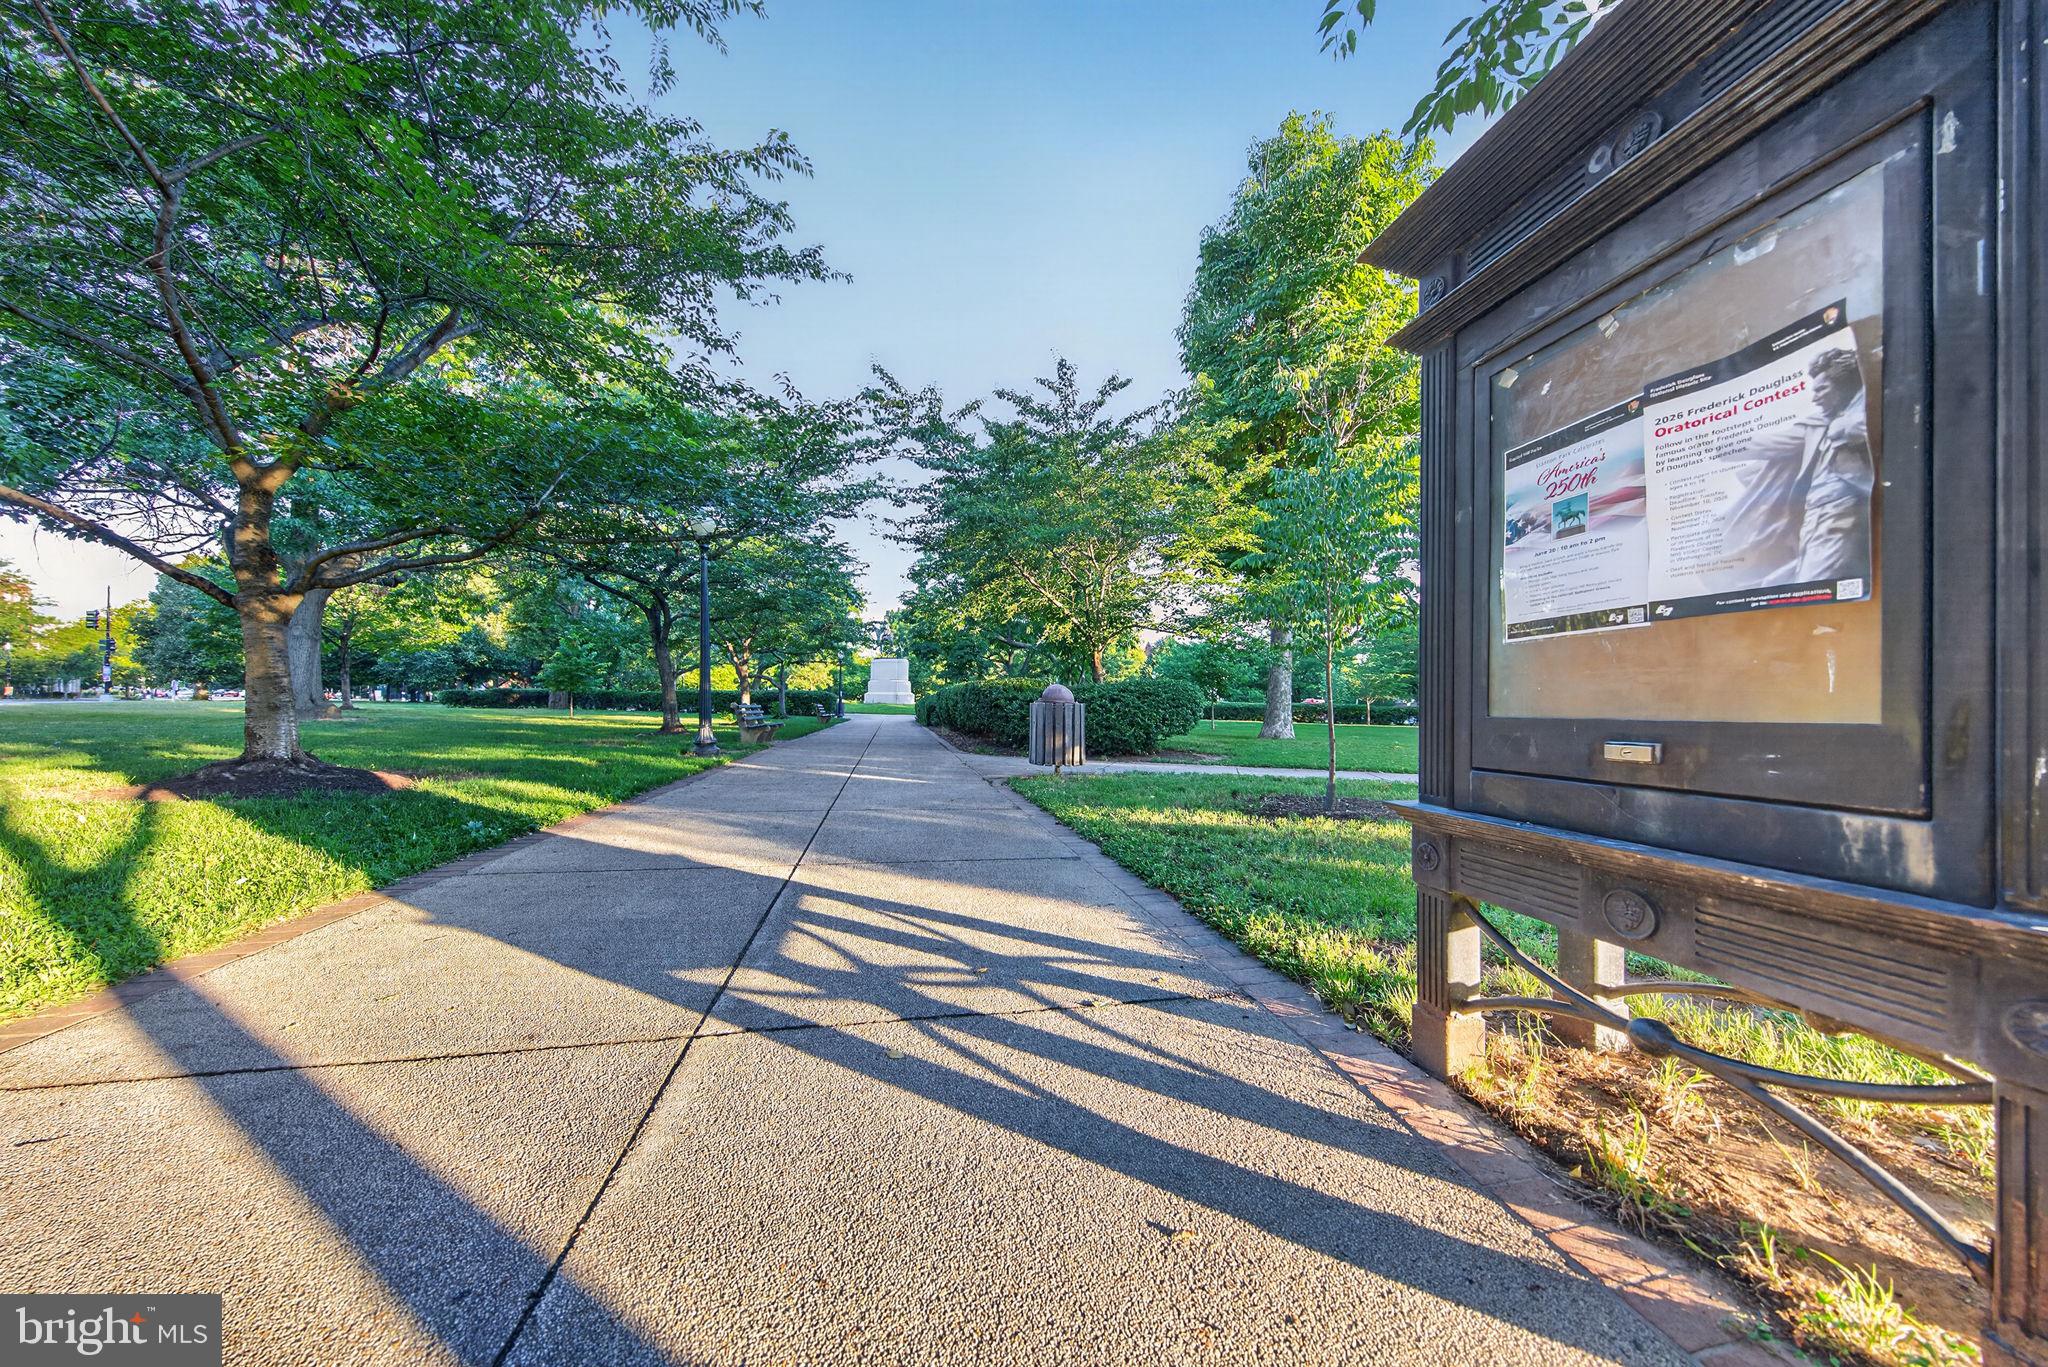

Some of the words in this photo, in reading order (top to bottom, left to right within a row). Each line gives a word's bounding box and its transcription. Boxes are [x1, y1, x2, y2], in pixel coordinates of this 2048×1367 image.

[1654, 411, 1683, 426] 2026
[1687, 392, 1745, 417] Frederick
[1749, 369, 1804, 397] Douglass
[1654, 405, 1738, 438] Oratorical
[1743, 381, 1806, 412] Contest
[1655, 439, 1683, 452] Follow
[1684, 436, 1693, 444] in
[1694, 432, 1709, 442] the
[1711, 420, 1751, 438] footsteps
[1753, 415, 1764, 424] of
[1655, 446, 1686, 459] famous
[1687, 440, 1714, 451] orator
[1716, 426, 1754, 443] Frederick
[1757, 413, 1797, 431] Douglass
[1655, 458, 1666, 467] by
[1667, 450, 1702, 464] learning
[1715, 441, 1734, 453] give
[1736, 437, 1752, 446] one
[1537, 447, 1606, 486] America's
[1544, 467, 1598, 500] 250th
[1655, 466, 1665, 474] of
[1534, 550, 1548, 558] June
